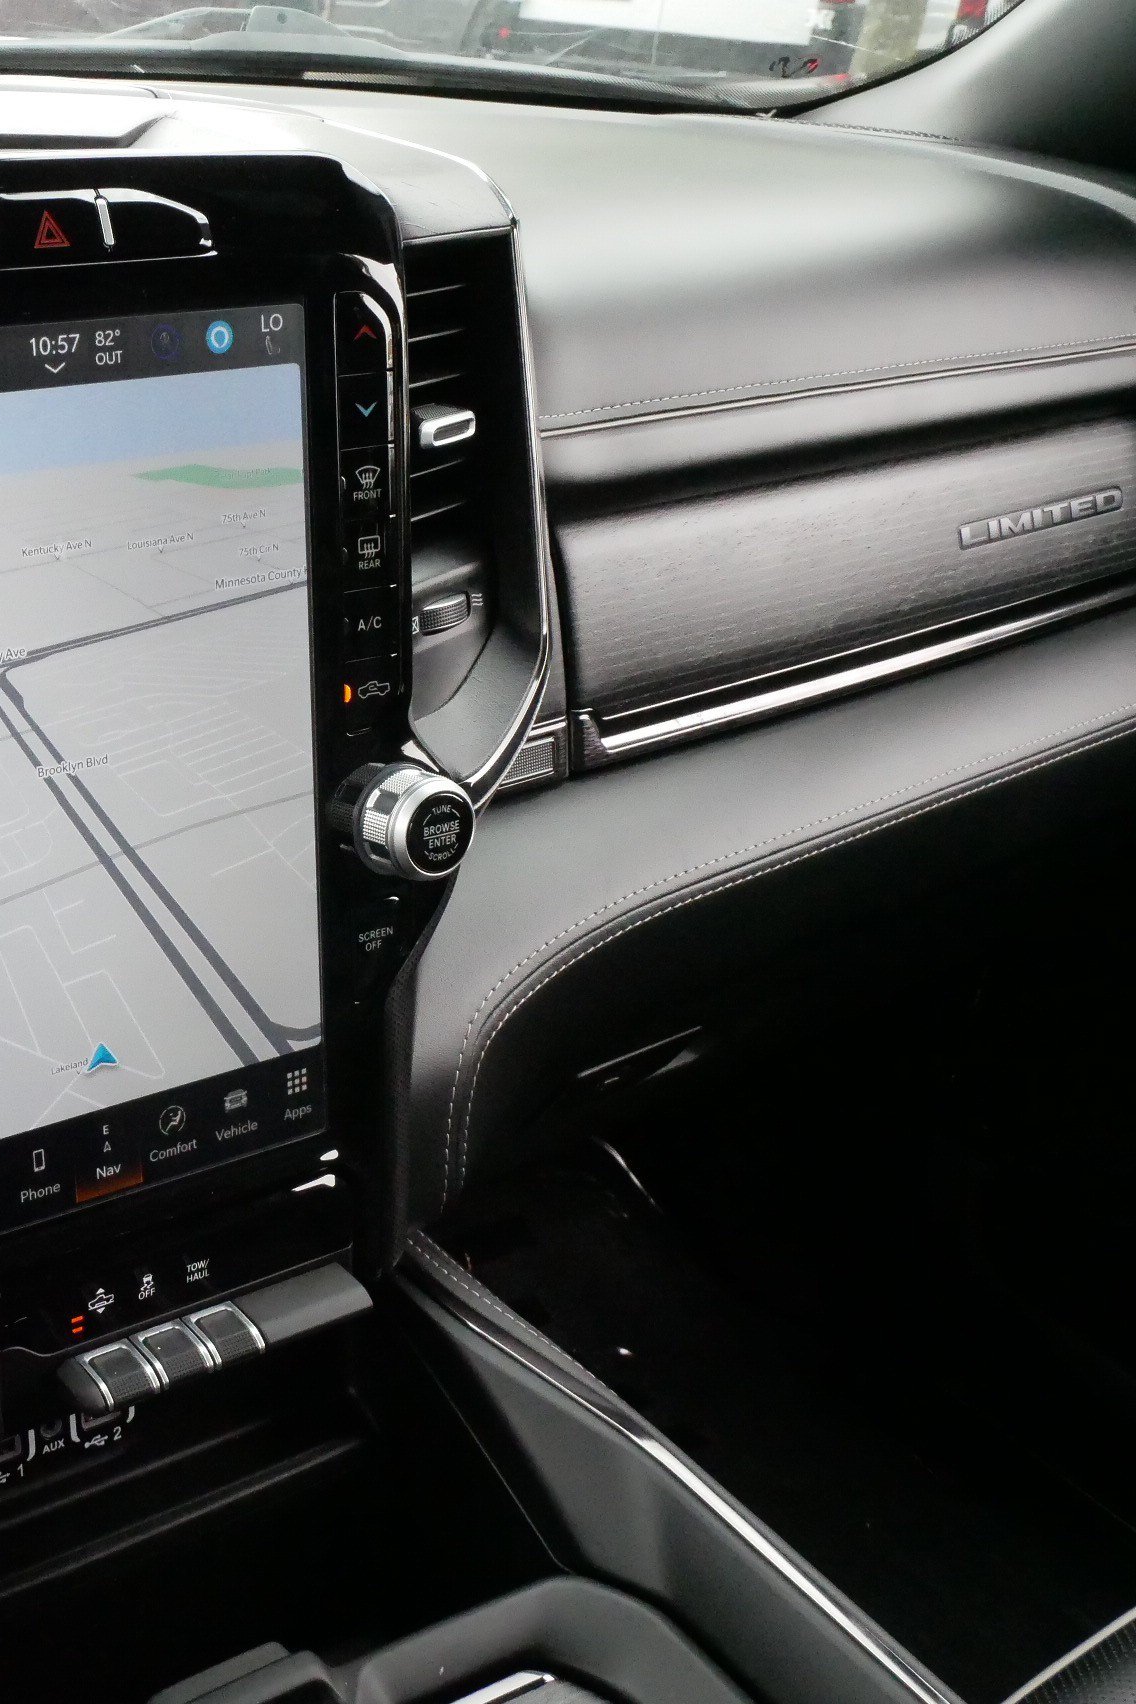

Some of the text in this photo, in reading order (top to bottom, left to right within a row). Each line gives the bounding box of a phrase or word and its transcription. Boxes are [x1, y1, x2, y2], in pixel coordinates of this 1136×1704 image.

[261, 313, 283, 332] LO
[29, 333, 80, 357] 10:57
[95, 329, 121, 348] 82°
[95, 350, 123, 366] OUT
[353, 488, 382, 501] FRONT
[221, 508, 266, 525] 75th Ave N
[959, 487, 1123, 548] LIMITED
[21, 538, 92, 558] Kentucky Ave N
[127, 532, 194, 551] Louisiana Ave N
[238, 543, 279, 559] 75th Cir N
[358, 558, 381, 571] REAR
[215, 573, 266, 591] Minnesota
[267, 567, 302, 583] County
[357, 616, 382, 632] A/C
[5, 647, 26, 661] Ave
[37, 754, 108, 778] Brooklyn Blvd
[432, 804, 452, 815] TUNE
[424, 820, 460, 837] BROWSE
[428, 834, 457, 849] ENTER
[428, 848, 455, 861] SCROLL
[358, 926, 394, 943] SCREEN
[365, 940, 382, 952] OFF
[50, 1057, 88, 1076] Lakeland
[284, 1103, 312, 1121] Apps
[102, 1124, 110, 1136] E
[215, 1119, 258, 1141] Vehicle
[149, 1138, 198, 1162] Comfort
[96, 1163, 121, 1180] Nav
[20, 1183, 61, 1203] Phone
[186, 1258, 210, 1273] TOW/
[186, 1268, 210, 1284] HAUL
[138, 1288, 156, 1301] OFF
[113, 1426, 122, 1442] 2
[42, 1438, 65, 1455] AUX
[17, 1463, 24, 1477] 1
